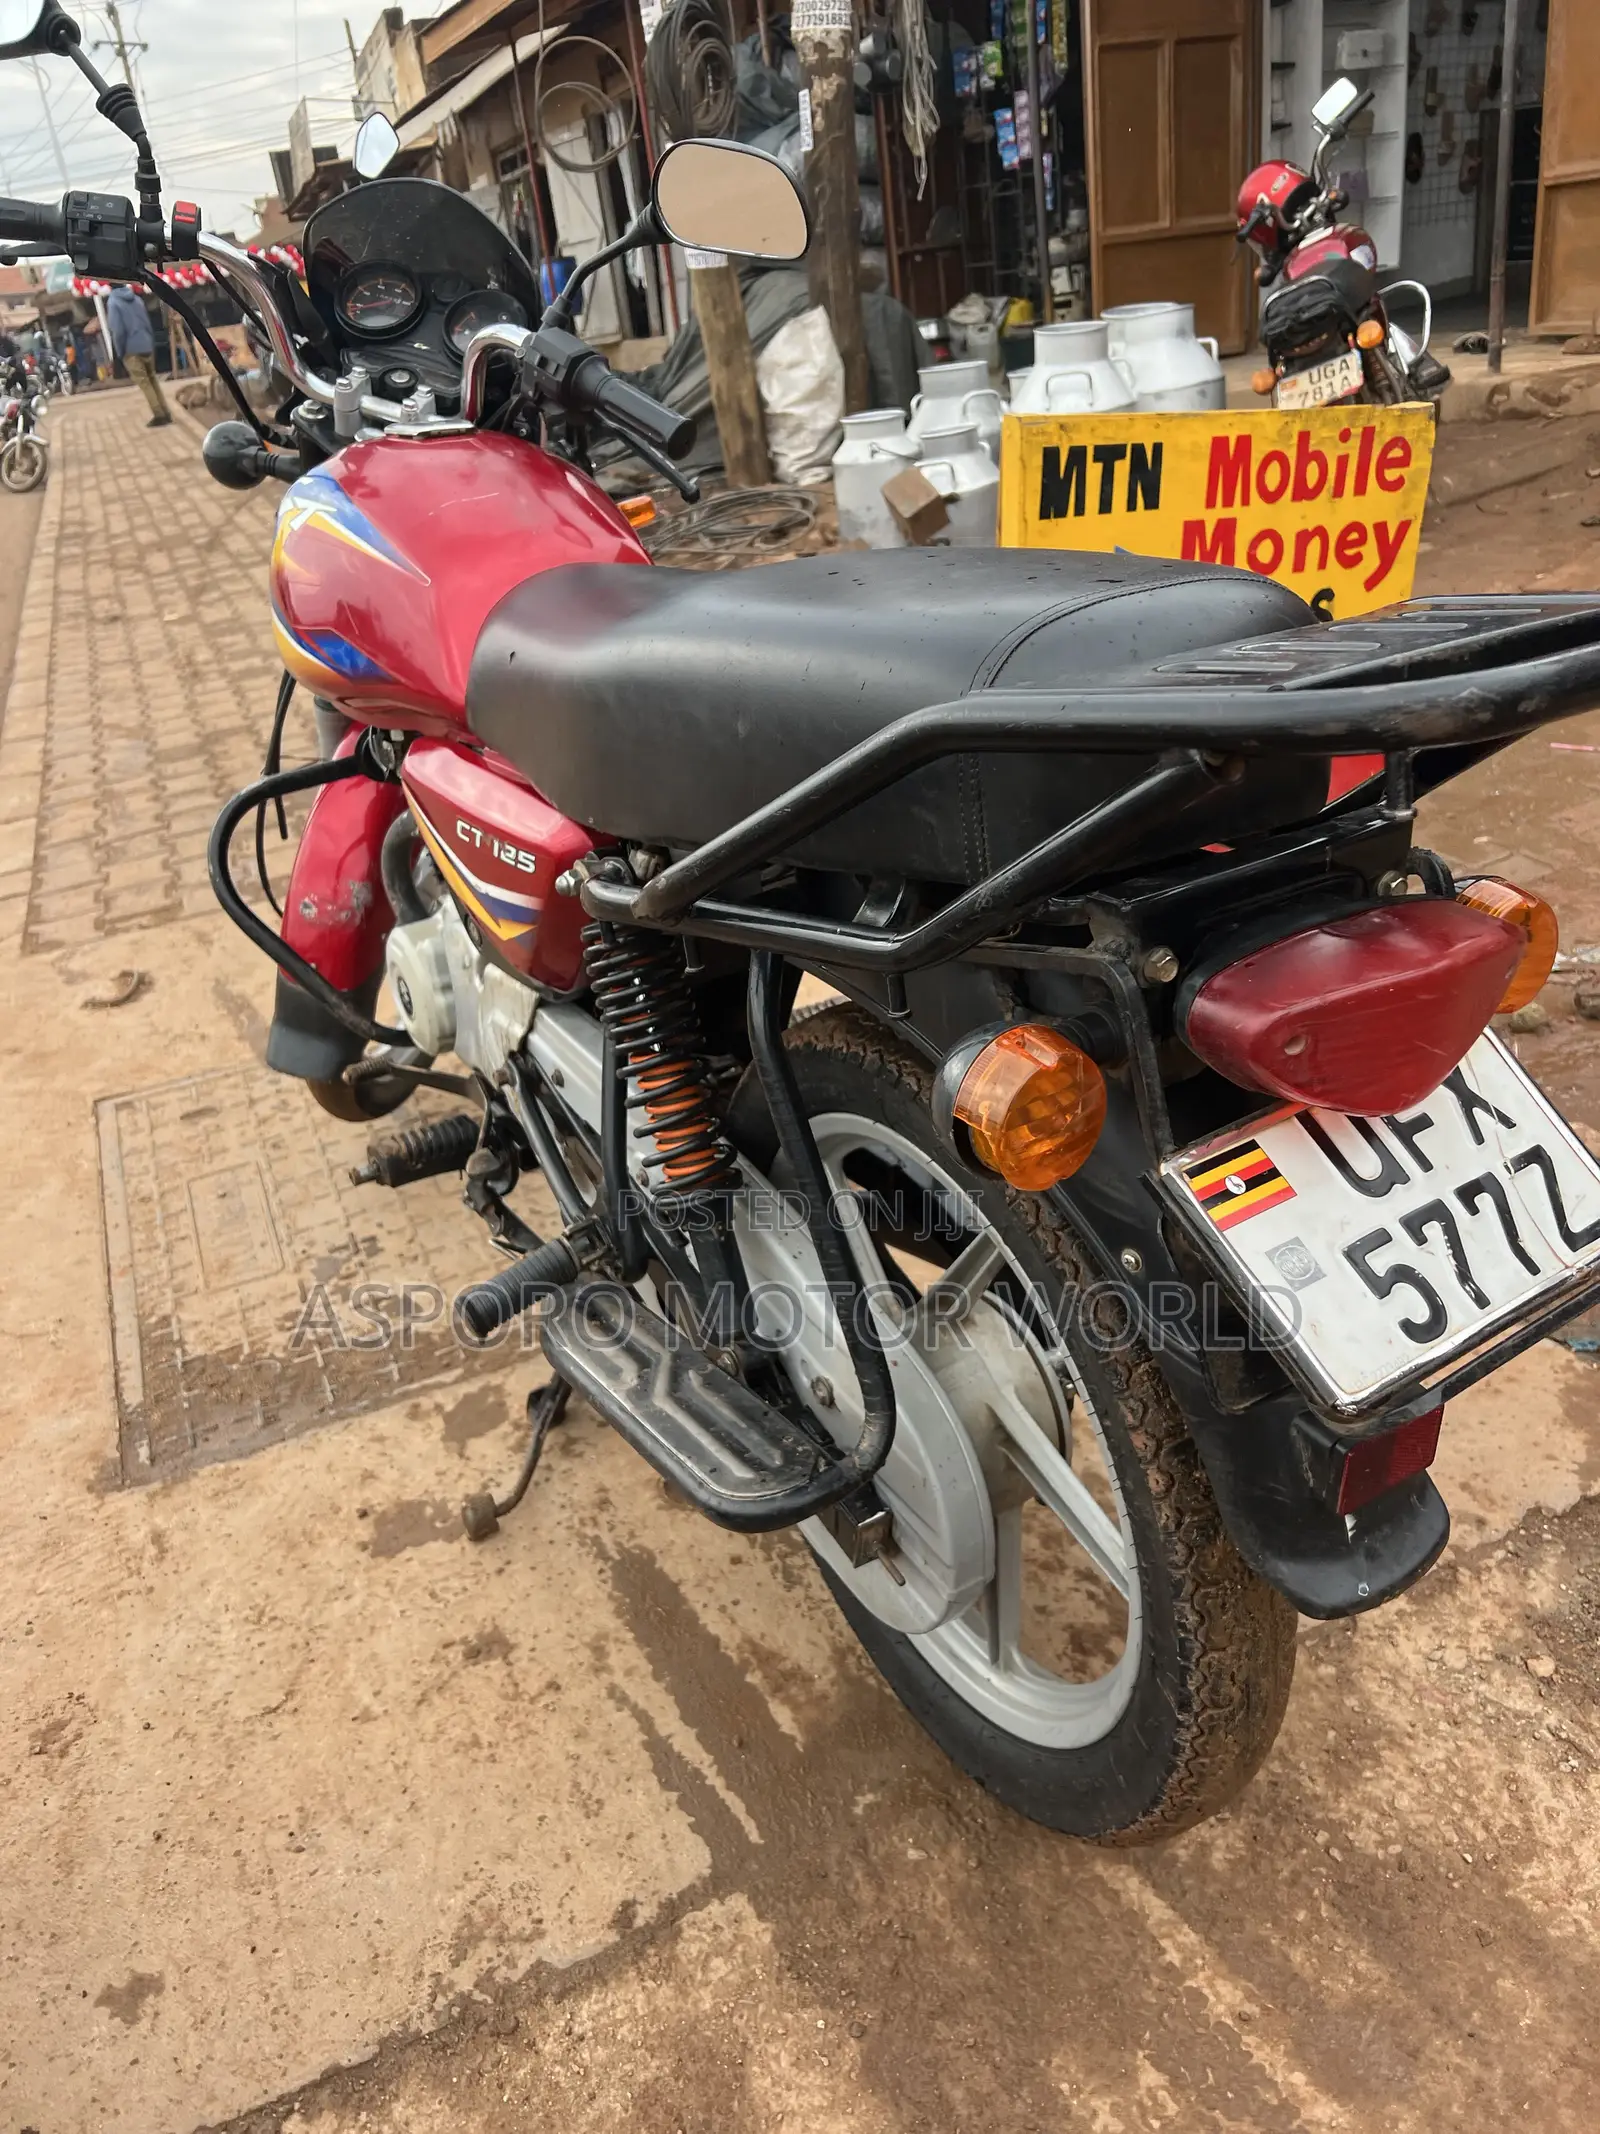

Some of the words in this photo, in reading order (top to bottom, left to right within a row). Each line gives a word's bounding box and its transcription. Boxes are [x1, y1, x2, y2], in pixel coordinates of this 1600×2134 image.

[1298, 375, 1352, 408] 781A
[1308, 358, 1350, 385] UGA
[1039, 441, 1163, 521] MTN
[1205, 425, 1412, 510] Mobile
[1180, 517, 1412, 592] Money
[456, 818, 484, 849] CT
[492, 838, 537, 875] 125
[1342, 1143, 1600, 1345] 577Z
